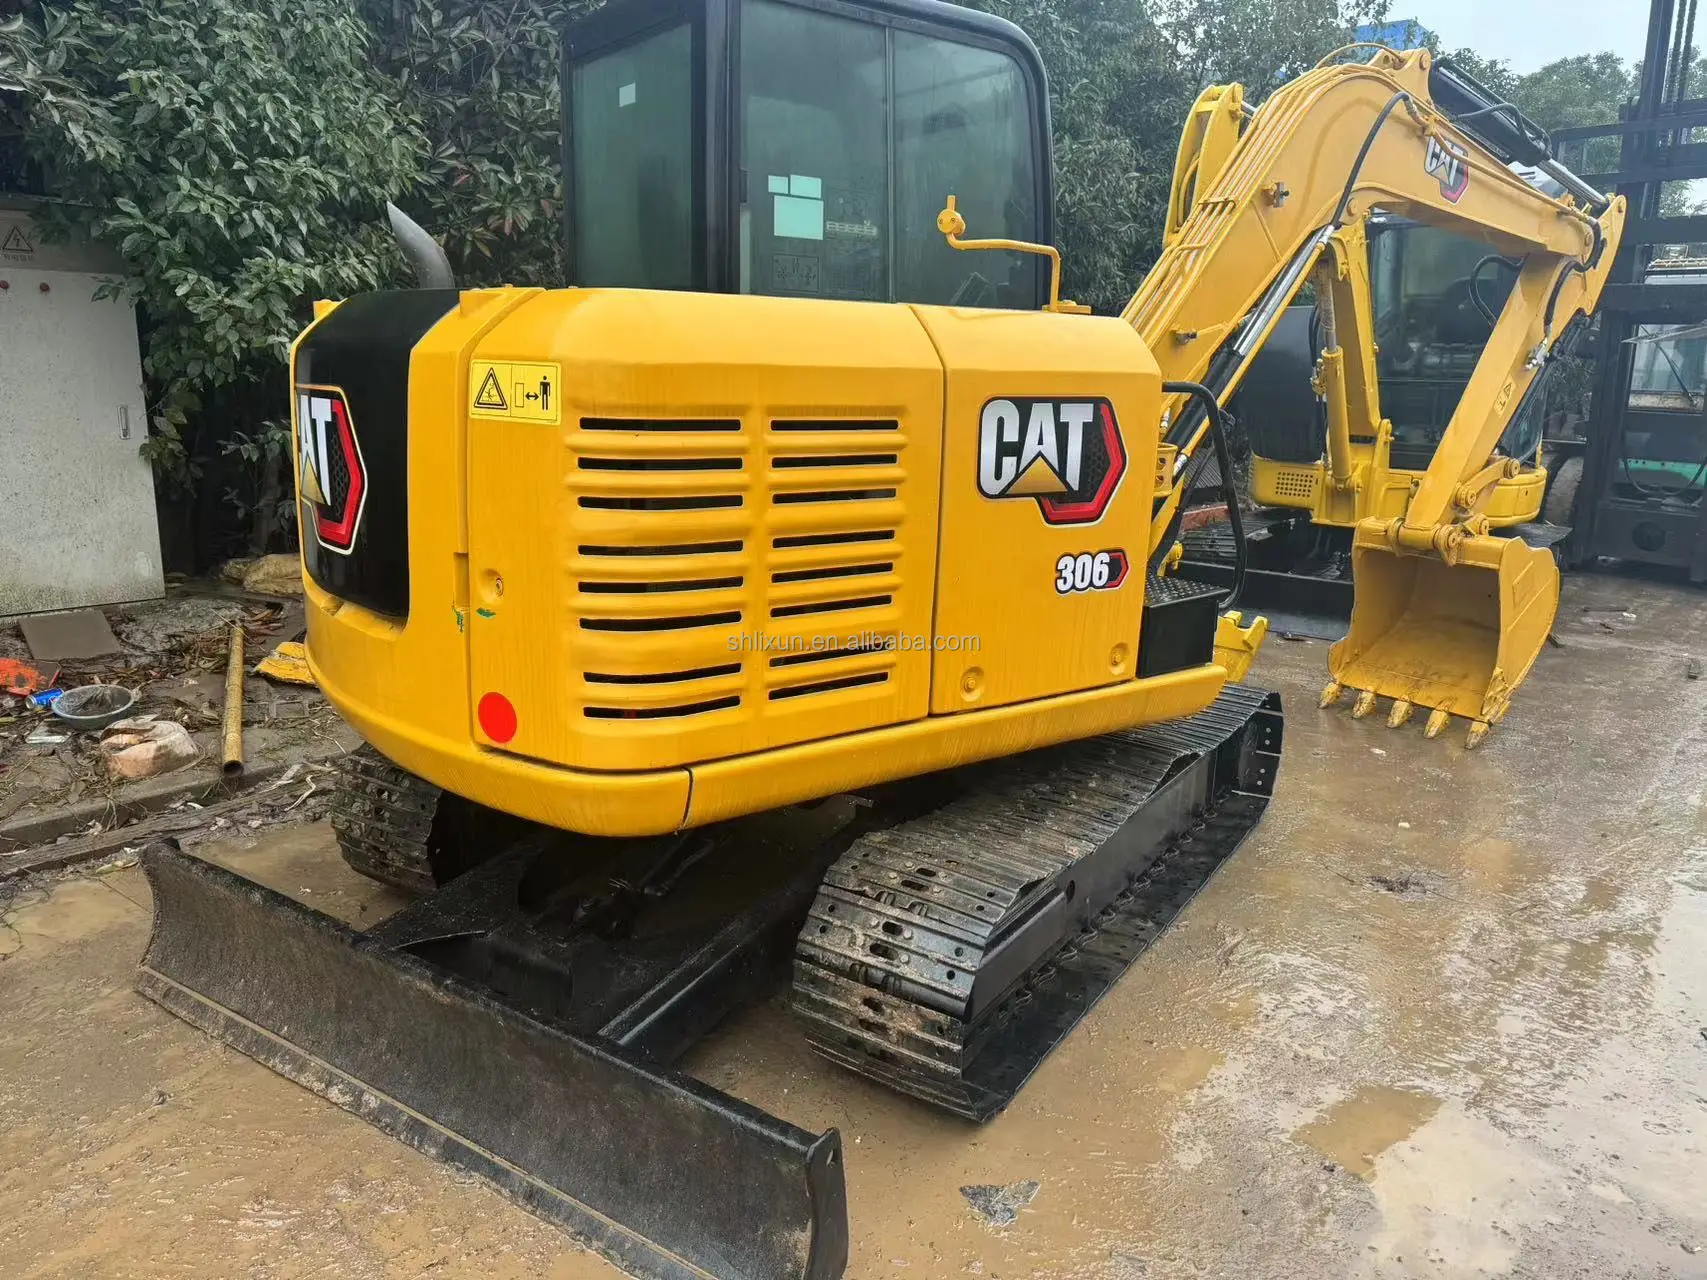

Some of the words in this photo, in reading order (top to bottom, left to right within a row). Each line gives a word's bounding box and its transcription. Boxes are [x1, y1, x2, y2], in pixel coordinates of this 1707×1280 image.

[297, 394, 332, 506] AT
[980, 400, 1094, 495] CAT
[1057, 552, 1110, 591] 306
